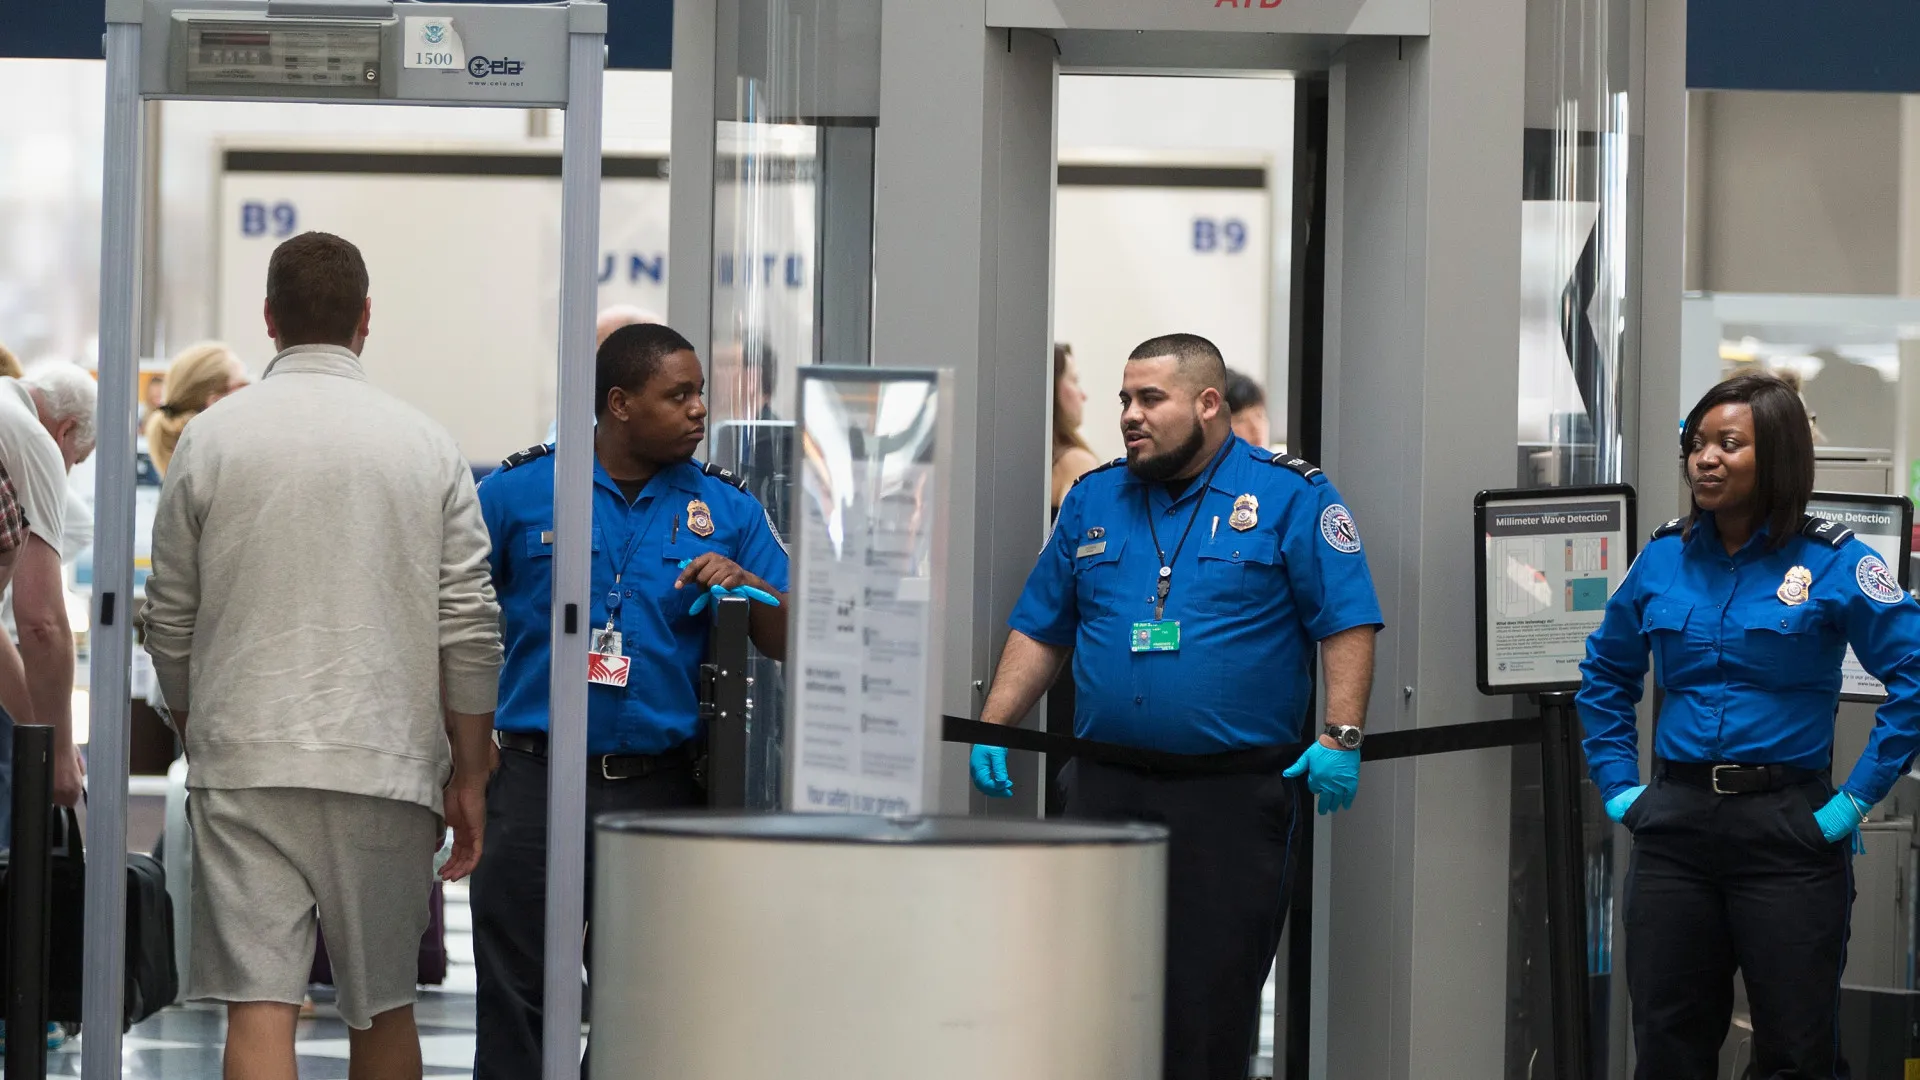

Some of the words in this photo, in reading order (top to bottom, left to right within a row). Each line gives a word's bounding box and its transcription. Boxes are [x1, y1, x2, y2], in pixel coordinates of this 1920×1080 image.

[416, 53, 452, 65] 1500
[241, 202, 296, 236] B9
[1193, 218, 1246, 252] B9
[1496, 517, 1539, 526] Millimeter
[1541, 515, 1565, 524] Wave
[1567, 513, 1607, 523] Detection
[1816, 511, 1843, 520] Wave
[1845, 513, 1891, 524] Detection
